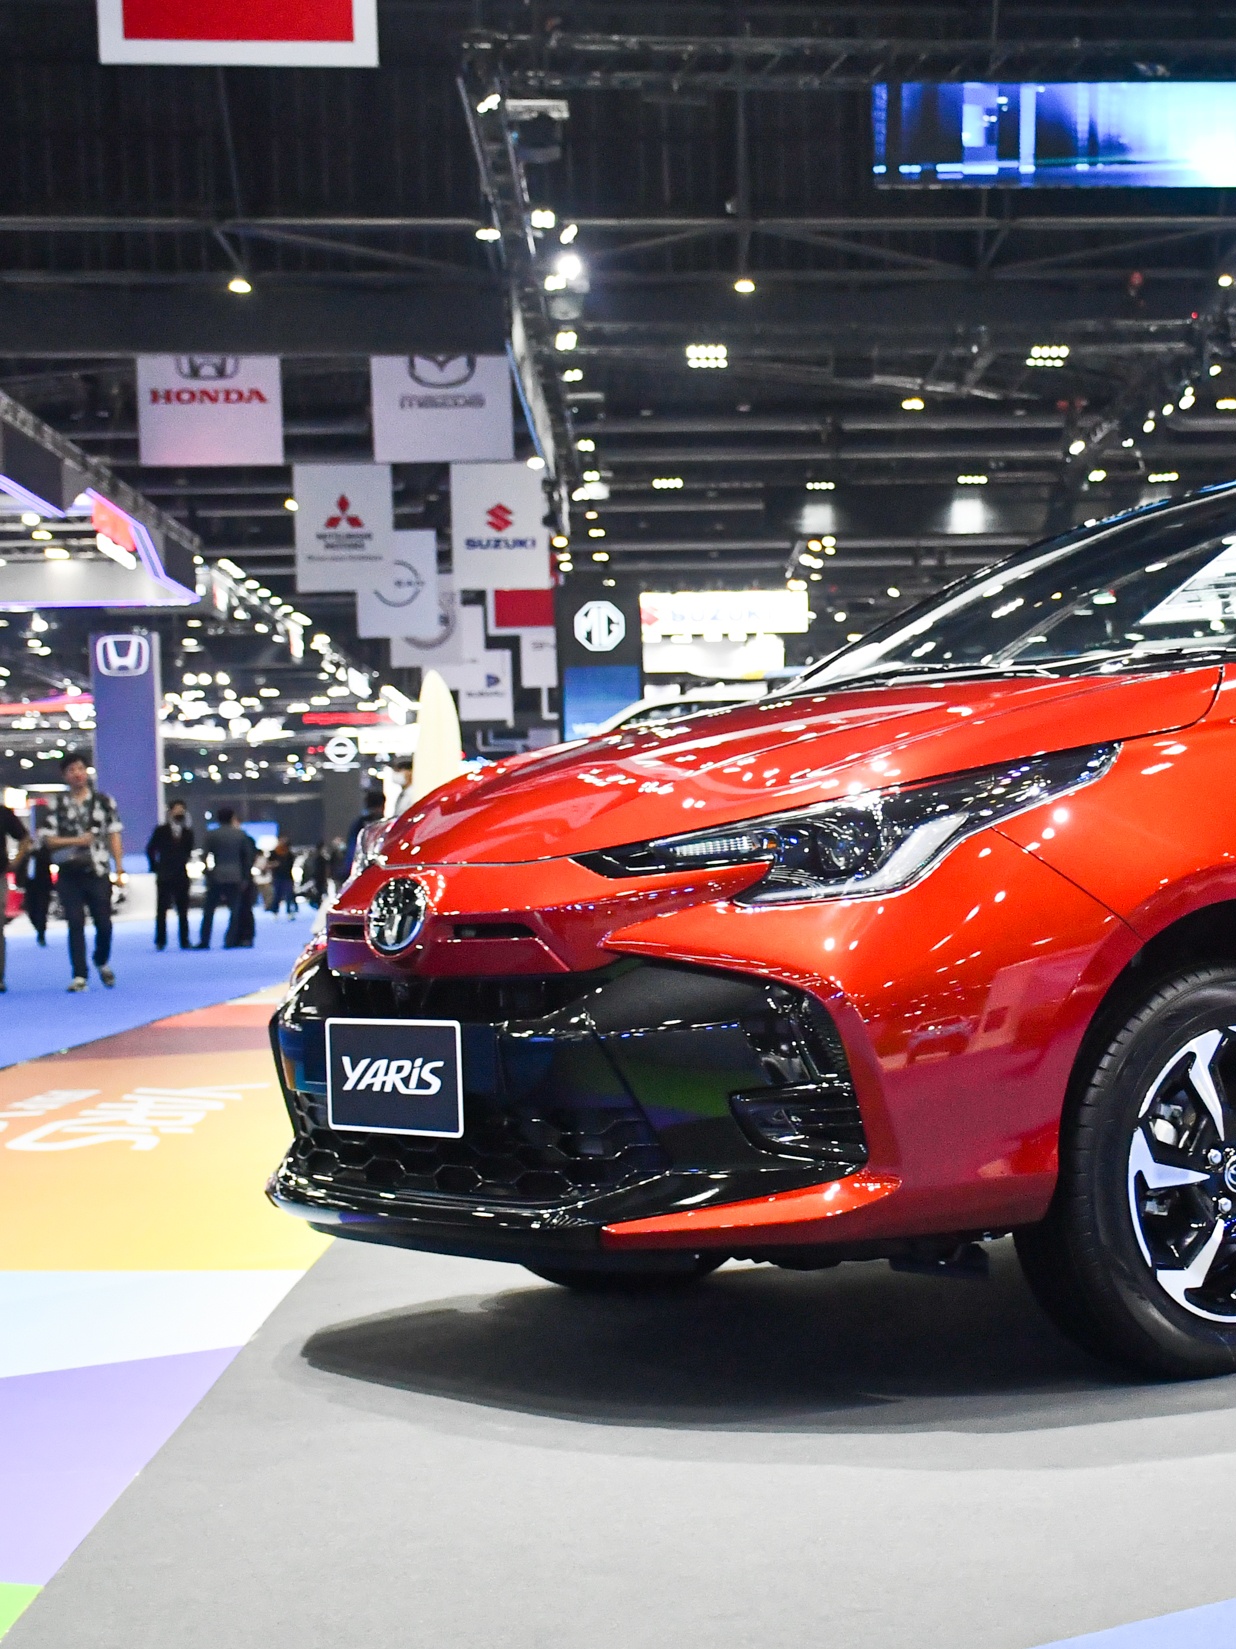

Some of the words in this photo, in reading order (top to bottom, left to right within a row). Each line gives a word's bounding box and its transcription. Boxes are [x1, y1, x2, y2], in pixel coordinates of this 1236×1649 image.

[149, 387, 268, 404] HONDA
[465, 538, 537, 550] SUZUKI
[577, 603, 622, 649] MG
